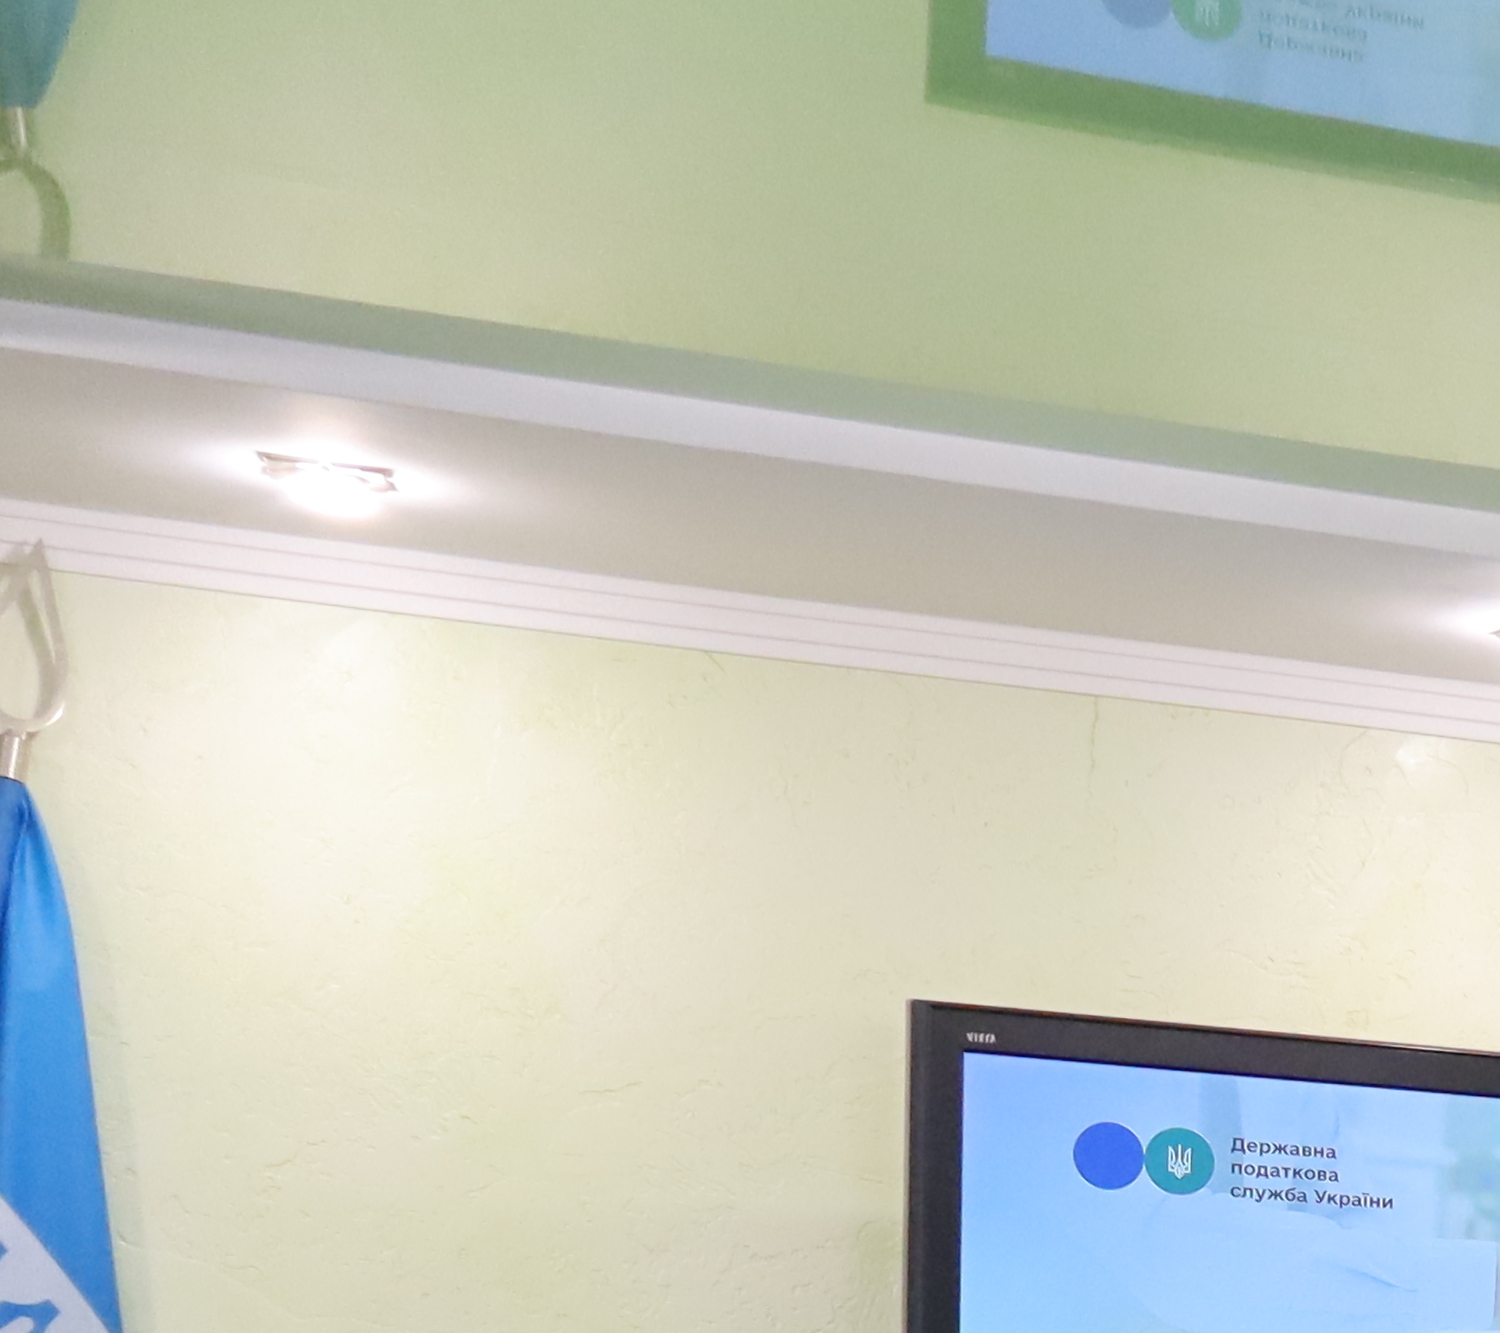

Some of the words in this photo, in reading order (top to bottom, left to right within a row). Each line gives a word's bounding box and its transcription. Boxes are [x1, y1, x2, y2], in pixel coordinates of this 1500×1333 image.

[1231, 1137, 1337, 1160] Державна
[1231, 1162, 1339, 1183] податкова
[1230, 1186, 1308, 1203] служба
[1314, 1189, 1393, 1209] України
